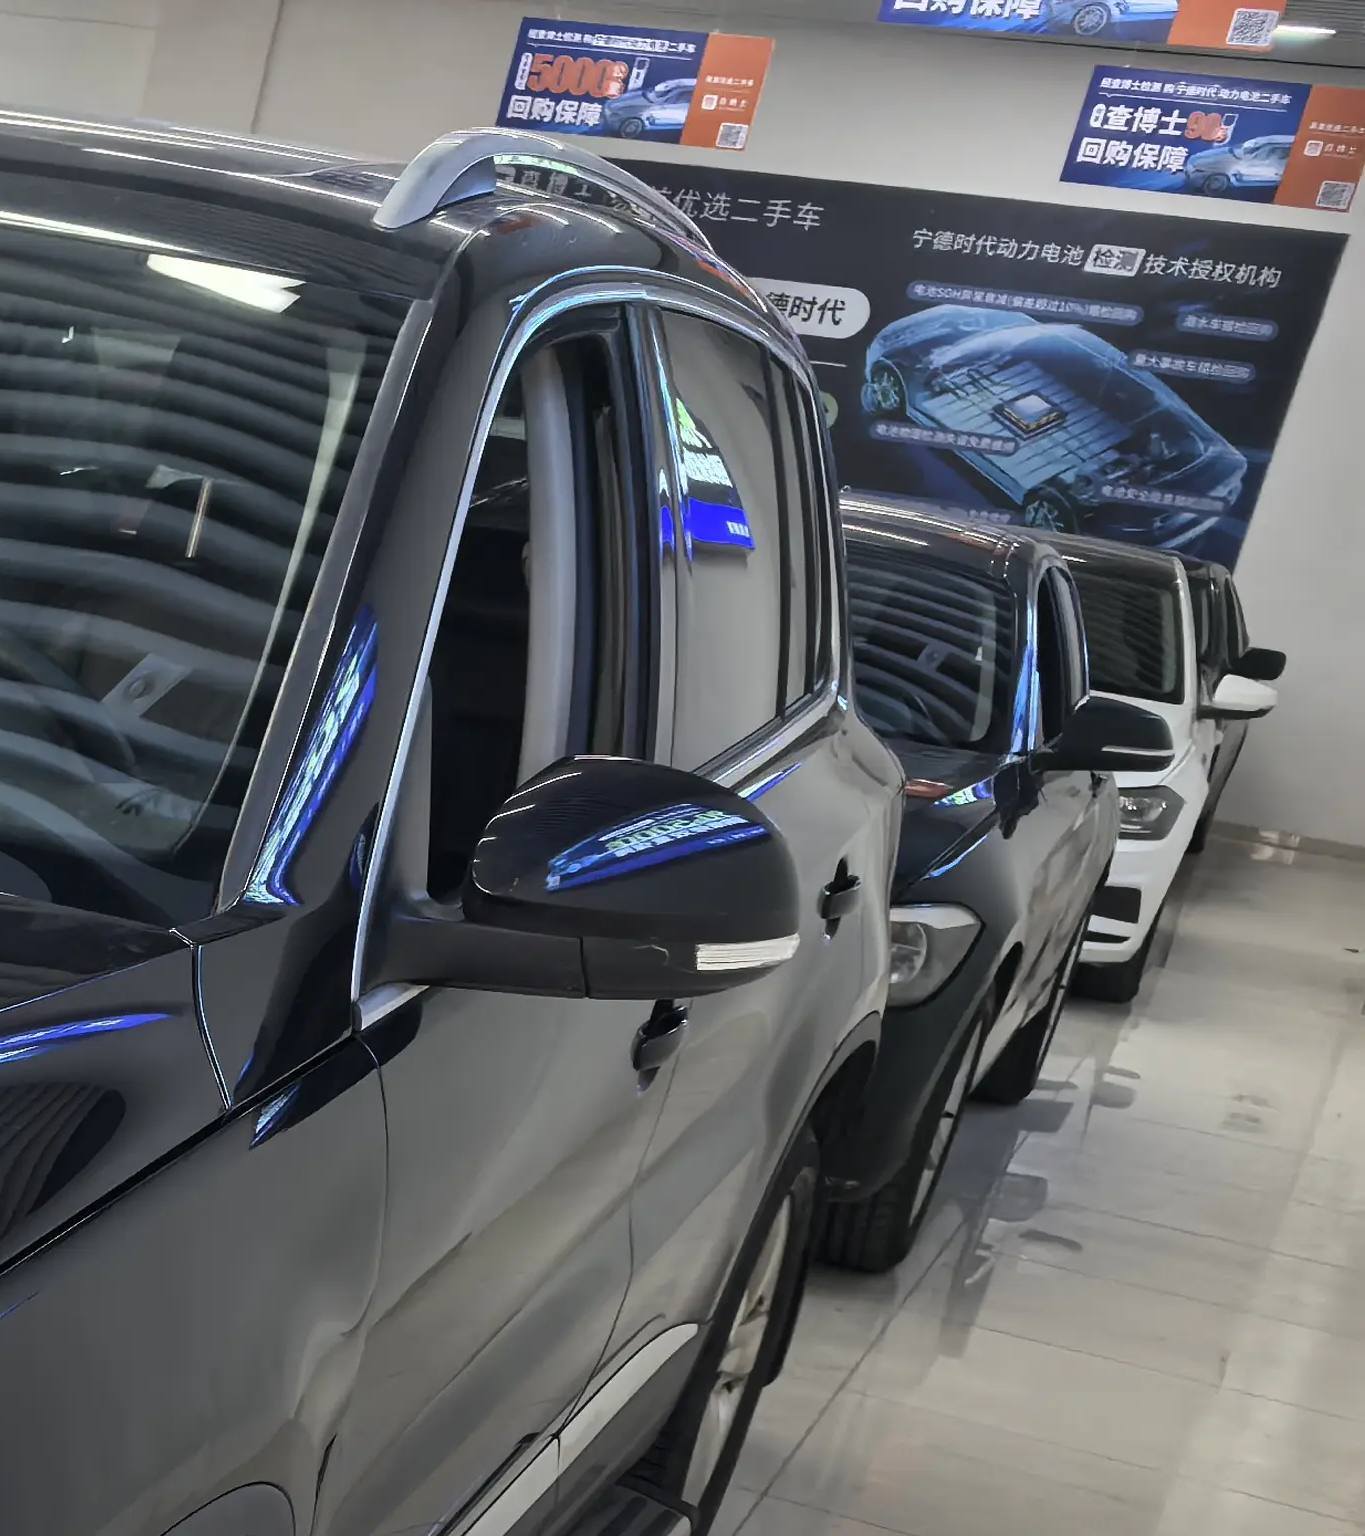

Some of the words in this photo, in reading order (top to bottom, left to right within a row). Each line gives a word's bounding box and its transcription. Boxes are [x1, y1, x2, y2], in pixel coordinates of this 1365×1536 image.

[506, 95, 603, 127] 回购保障
[1076, 137, 1189, 172] 回购保障
[912, 228, 1085, 267] 宁德时代动力电池
[1092, 246, 1138, 272] 检测
[1143, 254, 1282, 289] 技术授权机构
